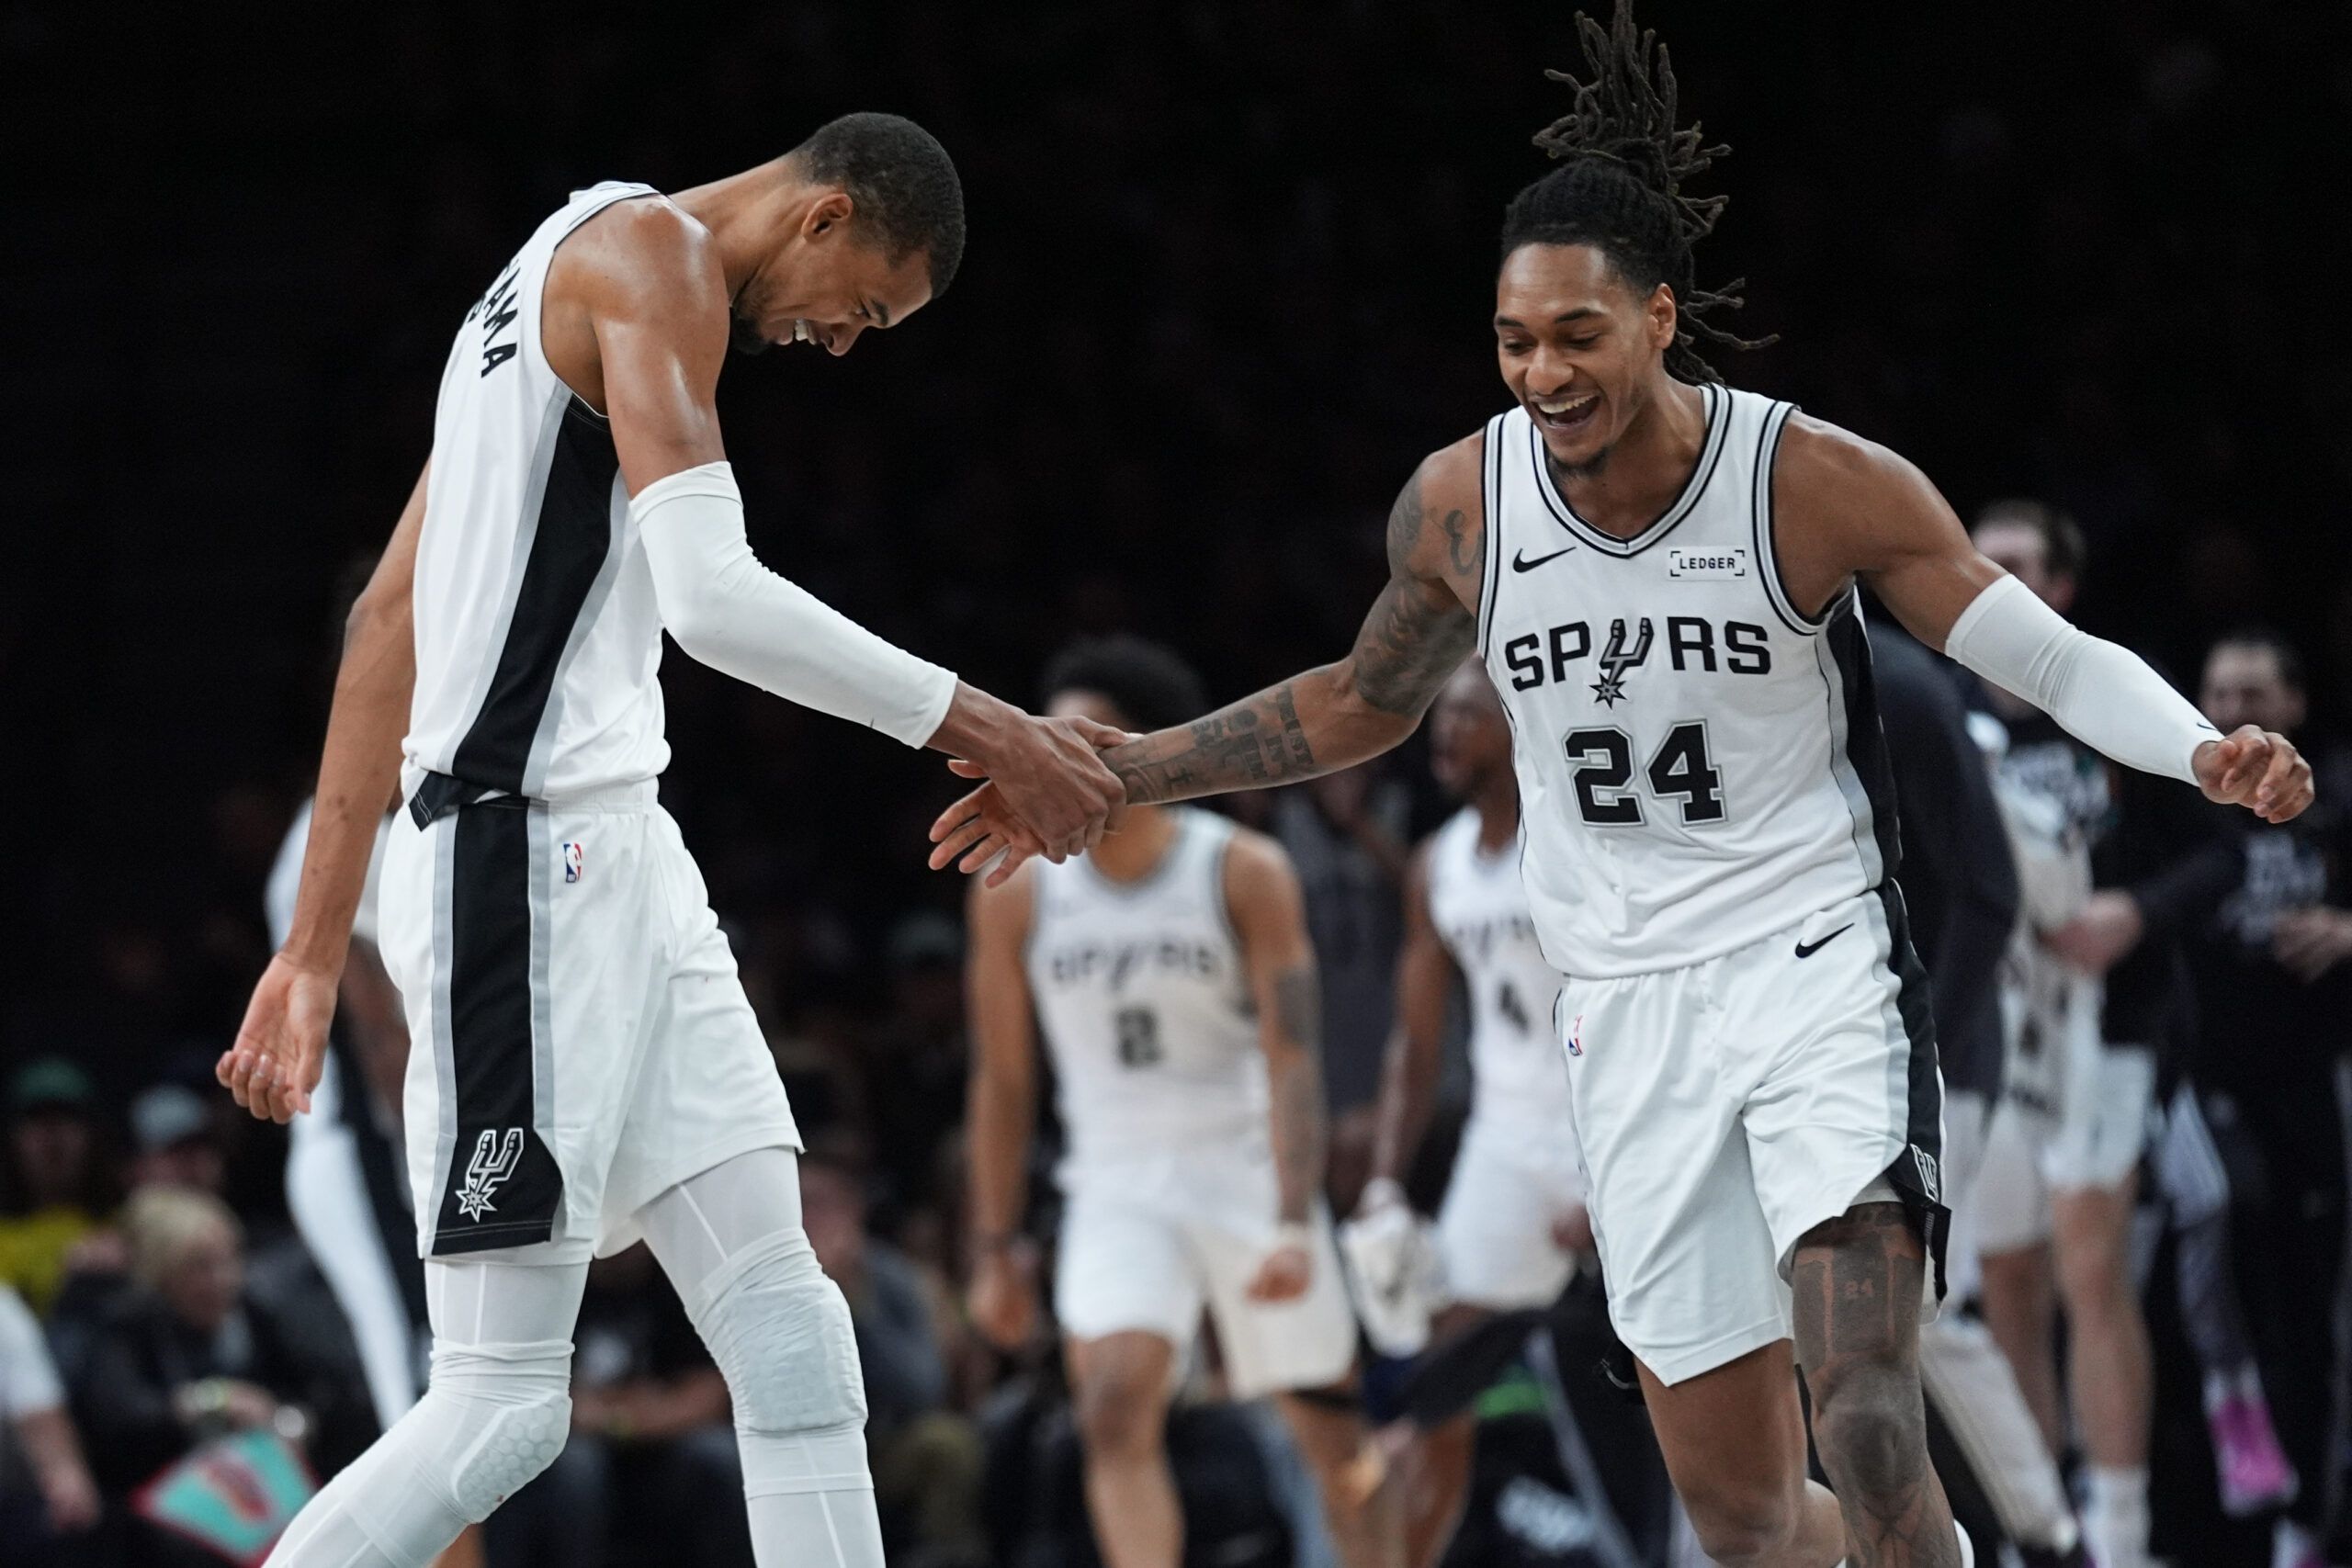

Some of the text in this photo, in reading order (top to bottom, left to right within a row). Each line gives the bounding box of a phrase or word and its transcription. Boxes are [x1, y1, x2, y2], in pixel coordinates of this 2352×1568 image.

[481, 260, 521, 378] AMA
[1679, 557, 1736, 570] LEDGER
[1505, 616, 1771, 710] SPURS
[1563, 718, 1729, 827] 24
